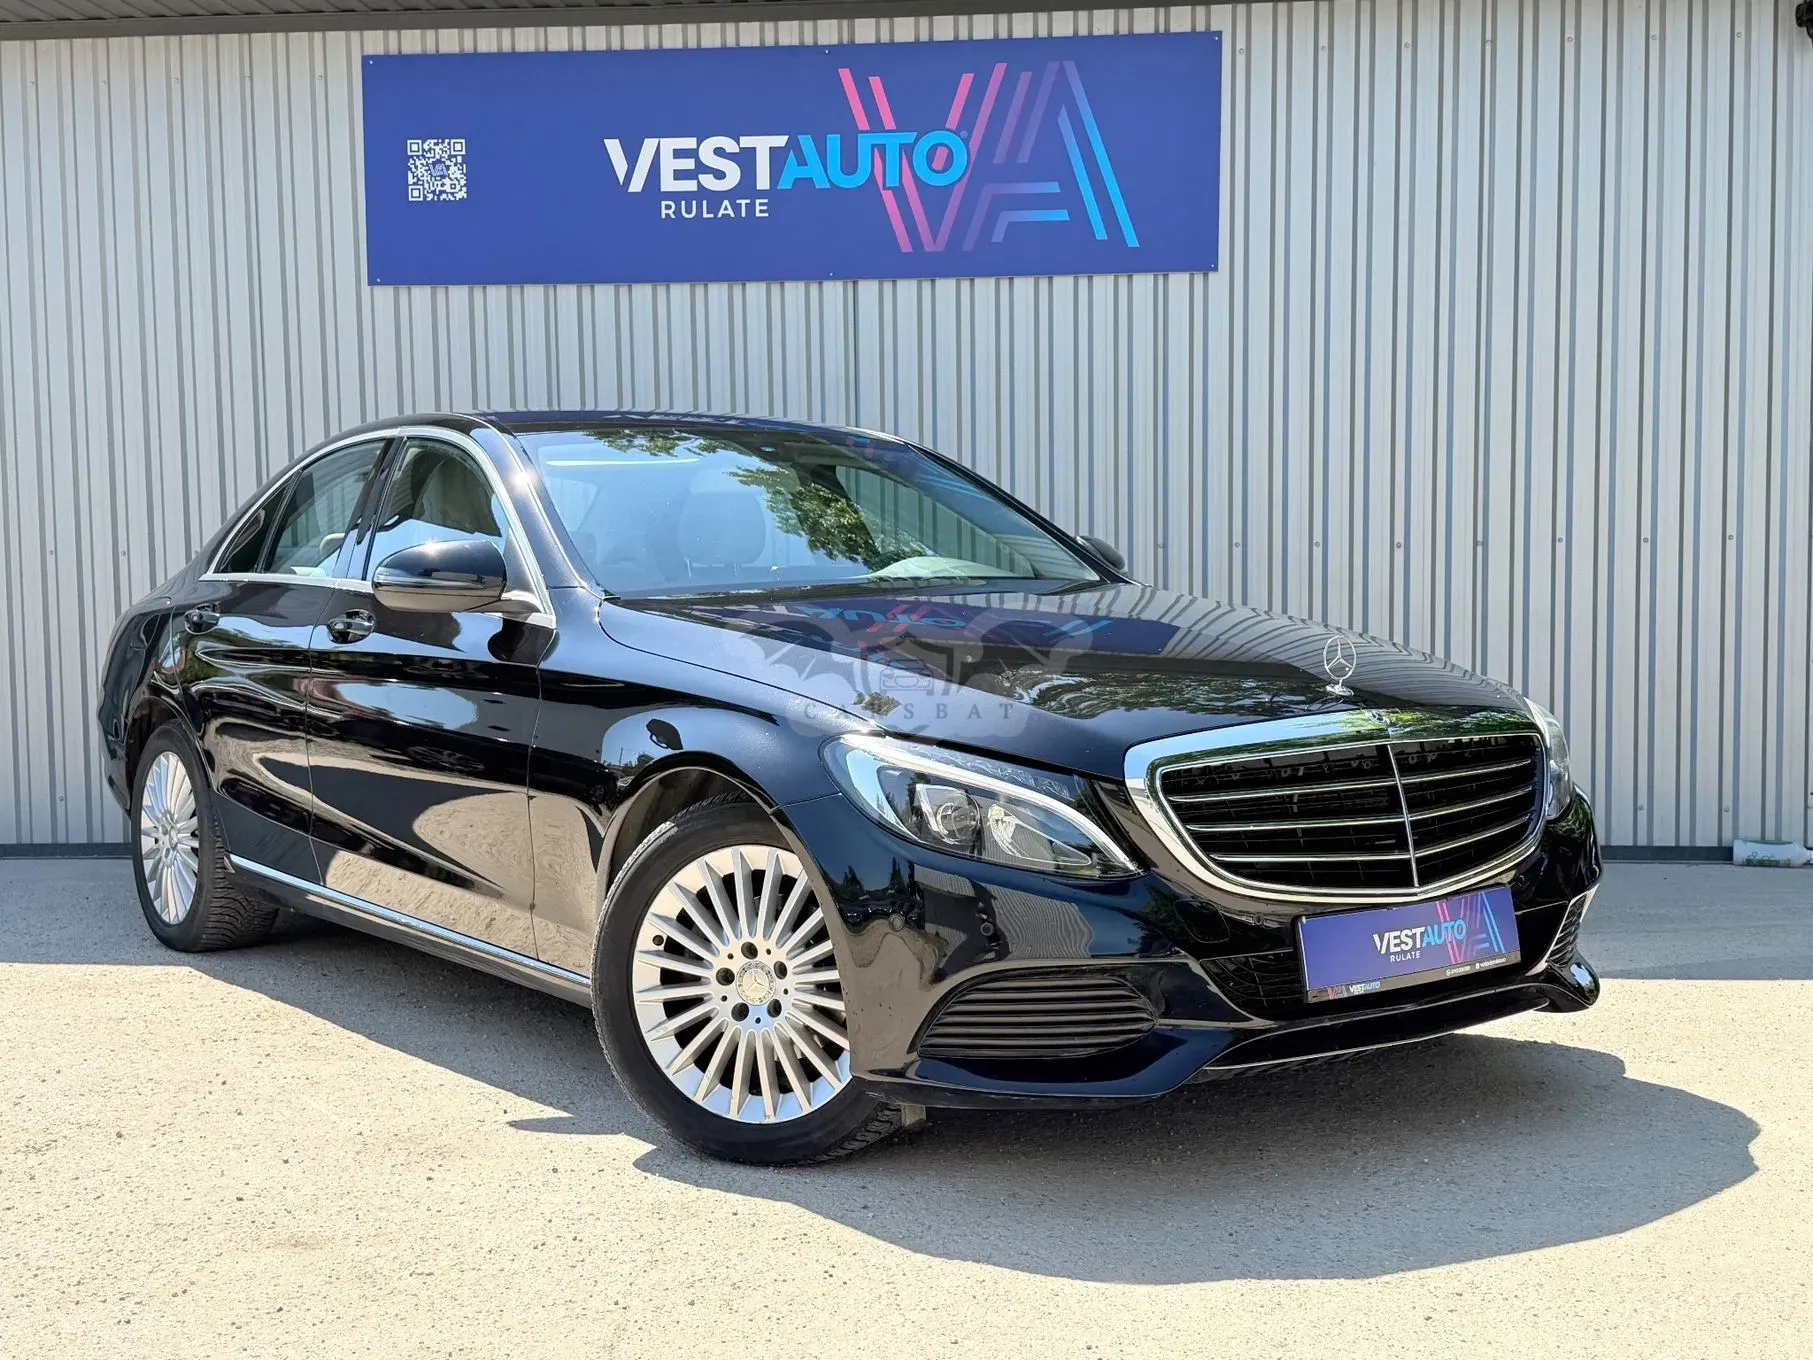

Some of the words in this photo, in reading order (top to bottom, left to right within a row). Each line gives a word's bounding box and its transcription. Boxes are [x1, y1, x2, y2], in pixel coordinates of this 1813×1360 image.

[603, 130, 968, 193] VESTAUTO
[660, 198, 770, 219] RULATE
[1372, 918, 1467, 955] VESTAUTO
[1390, 951, 1421, 963] RULATE
[1349, 981, 1381, 993] VESTAUTO
